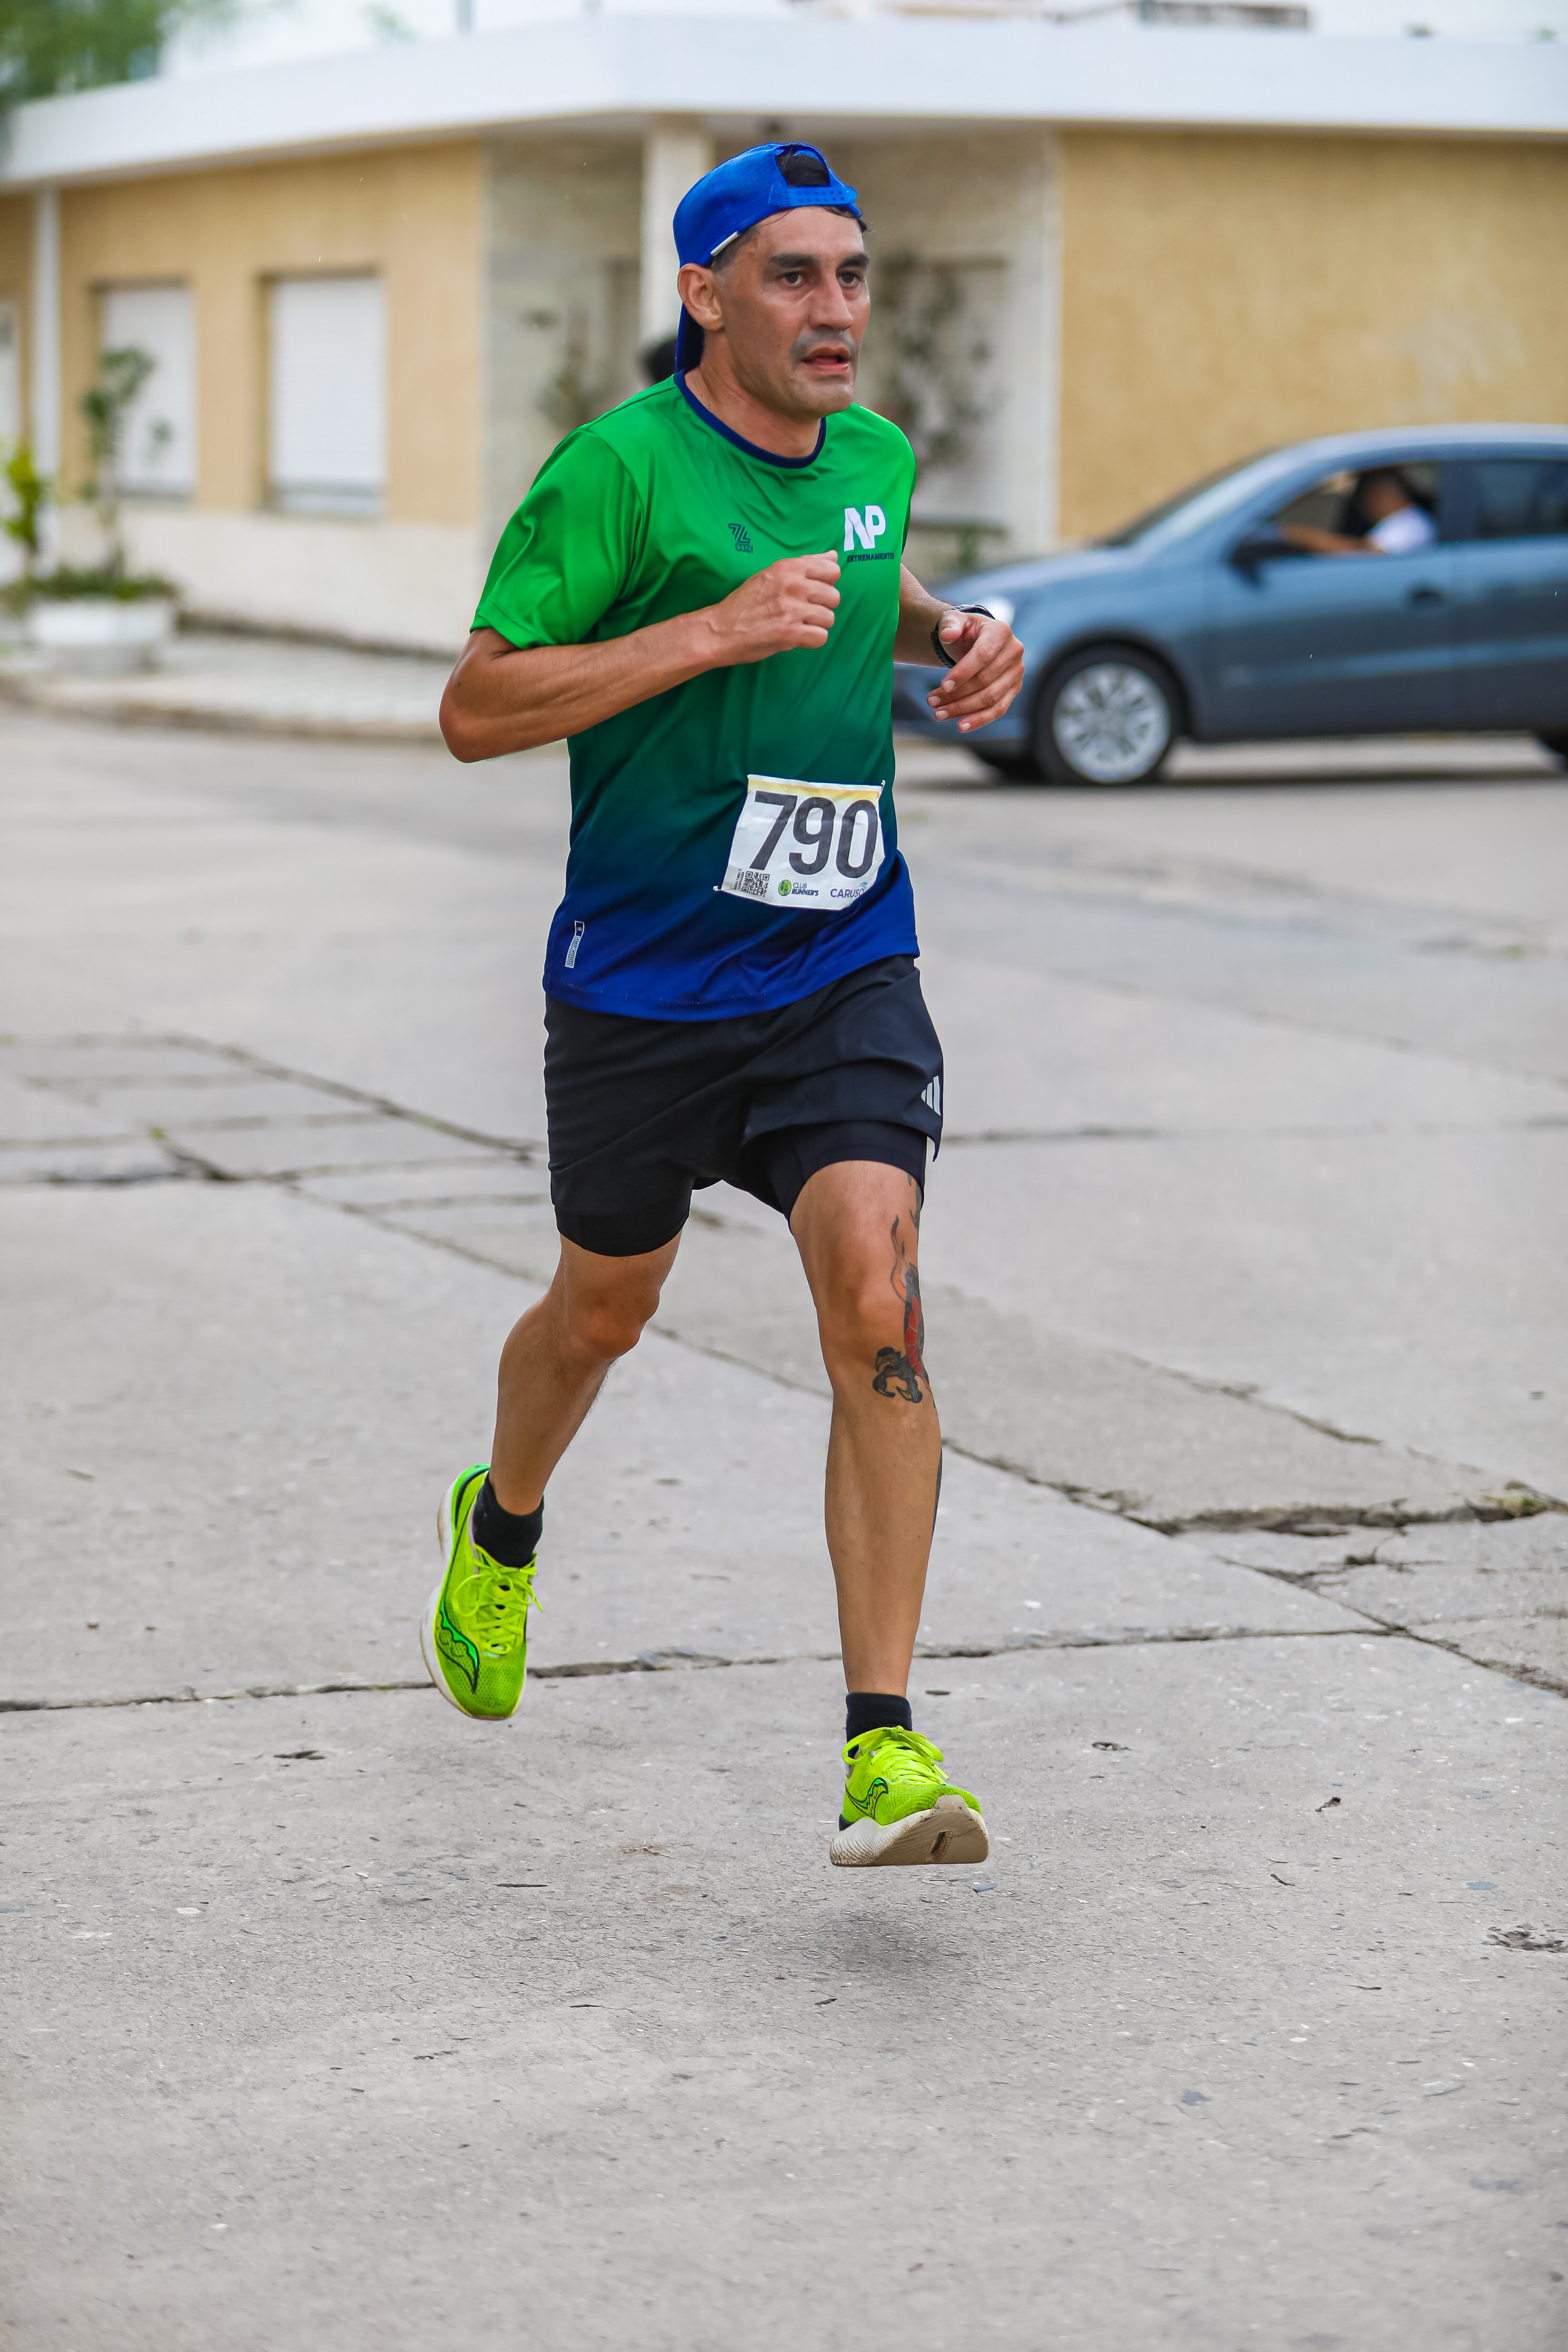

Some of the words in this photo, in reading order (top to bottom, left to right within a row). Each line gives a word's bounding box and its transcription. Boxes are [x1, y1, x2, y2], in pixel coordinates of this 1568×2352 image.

[844, 505, 886, 552] NP
[846, 552, 895, 563] ENTRENAMIENTOS
[749, 790, 878, 879] 790
